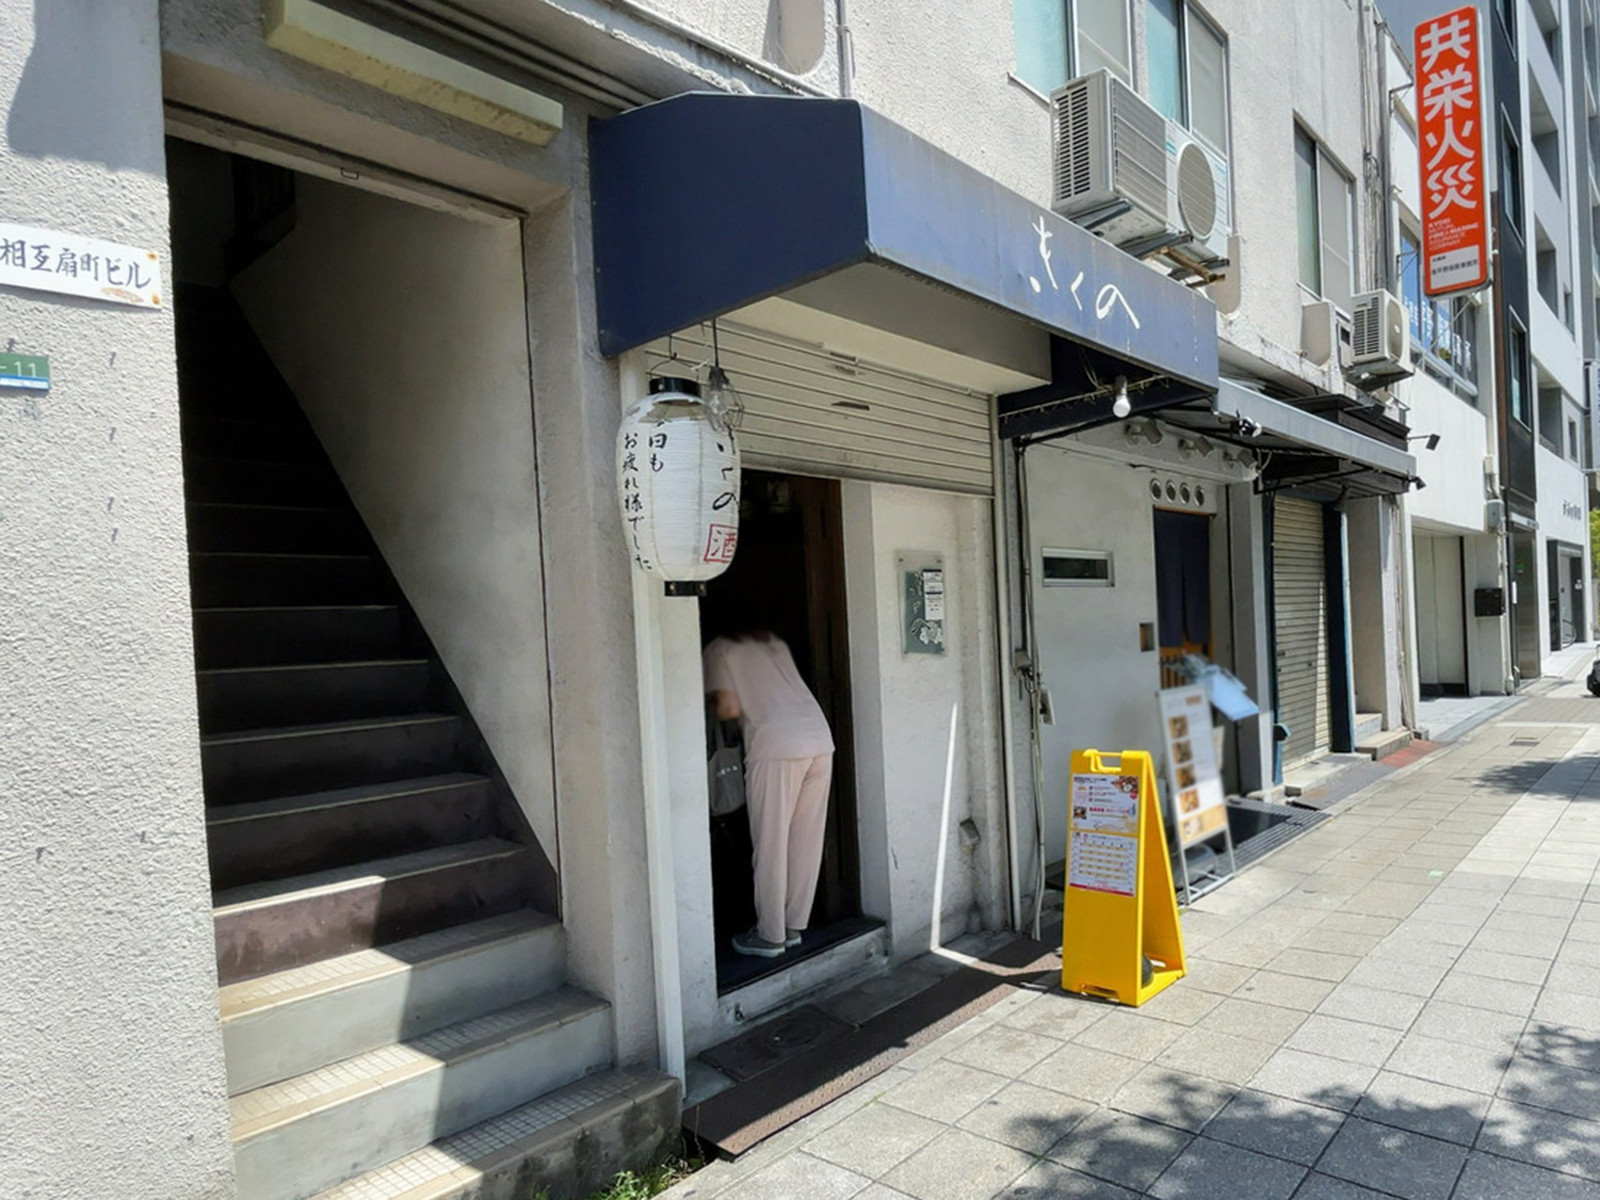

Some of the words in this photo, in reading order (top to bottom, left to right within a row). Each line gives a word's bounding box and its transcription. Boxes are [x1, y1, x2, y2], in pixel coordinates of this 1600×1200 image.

[1421, 14, 1477, 219] 共栄火災
[0, 238, 151, 288] 相互扇町ビル
[649, 420, 668, 472] 日も
[623, 432, 652, 571] お疲れ様でした
[708, 527, 738, 560] 酒
